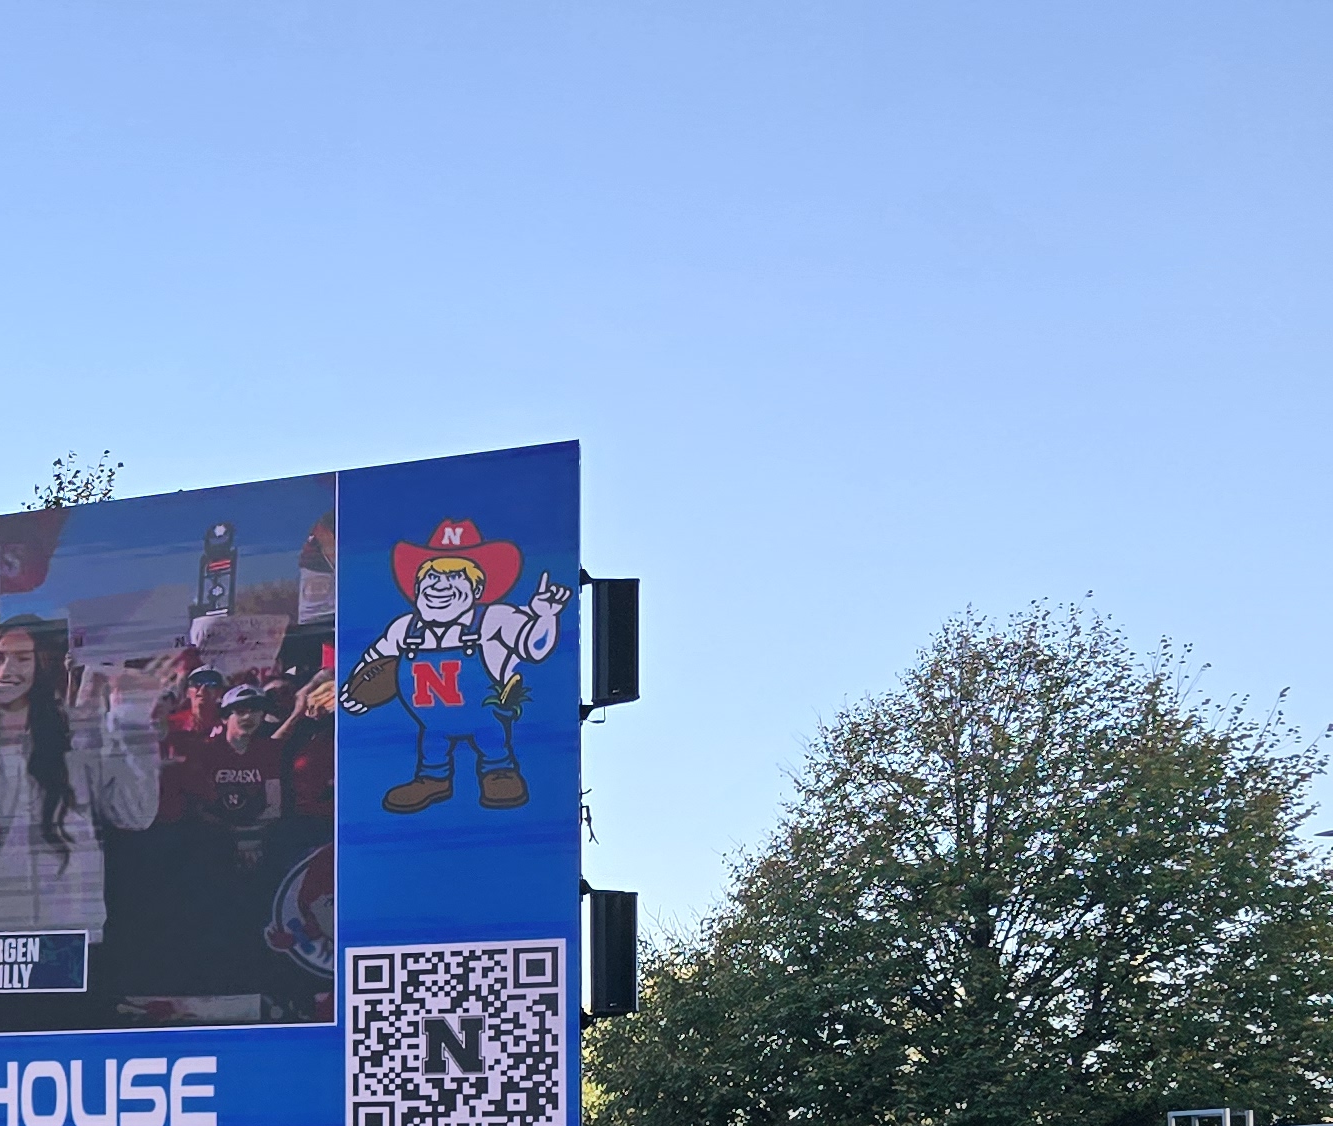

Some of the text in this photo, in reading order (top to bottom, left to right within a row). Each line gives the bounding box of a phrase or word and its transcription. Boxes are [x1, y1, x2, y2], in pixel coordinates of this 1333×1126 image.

[441, 526, 463, 546] N
[412, 660, 464, 708] N
[421, 1014, 486, 1077] N
